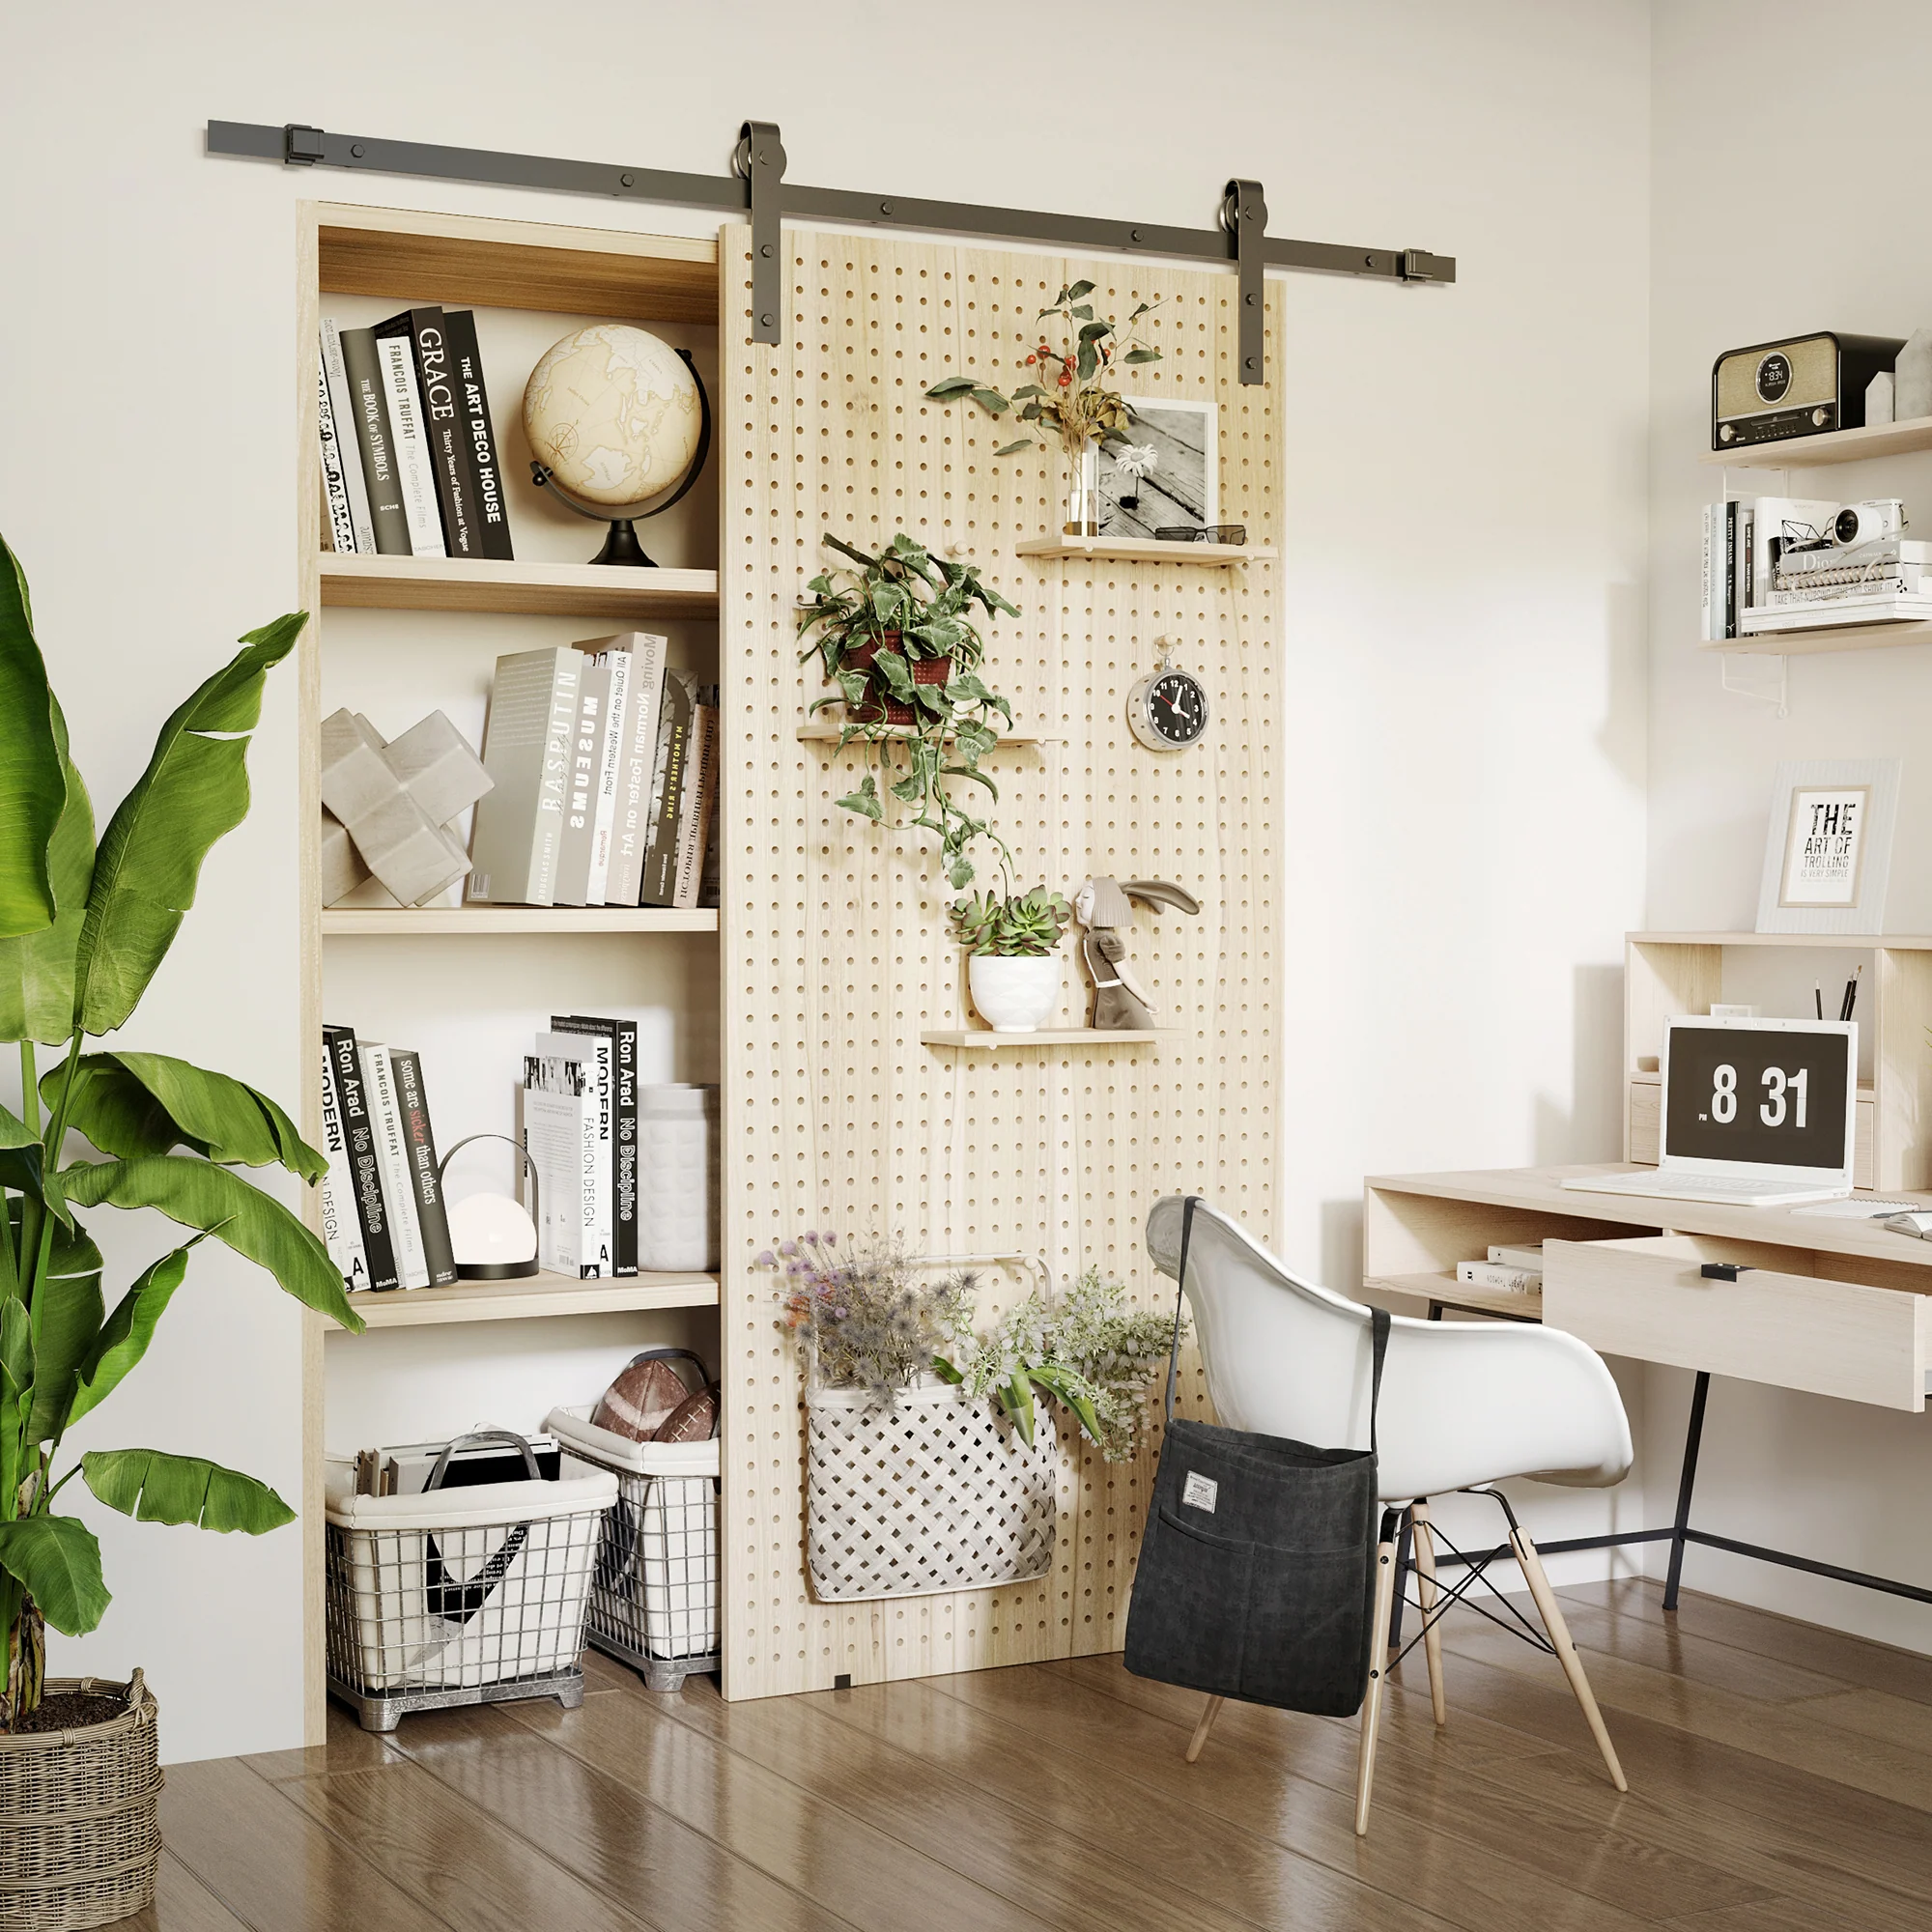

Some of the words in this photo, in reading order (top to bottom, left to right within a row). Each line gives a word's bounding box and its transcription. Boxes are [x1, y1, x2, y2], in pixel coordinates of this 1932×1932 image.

[389, 345, 407, 393] FRANCOIS
[419, 328, 454, 420] GRACE
[460, 356, 472, 379] THE
[361, 379, 370, 394] THE
[465, 384, 482, 415] ART
[366, 392, 380, 424] BOOK
[398, 398, 414, 440] TRUFFAT
[370, 422, 379, 436] OF
[442, 429, 454, 455] Thirty
[472, 421, 491, 462] DECO
[370, 433, 389, 481] SYMBOLS
[406, 444, 417, 461] The
[409, 463, 423, 504] Complete
[451, 475, 458, 486] of
[479, 468, 501, 524] HOUSE
[452, 482, 463, 514] Fashion
[415, 502, 426, 528] Films
[457, 515, 464, 526] at
[458, 526, 469, 552] Vogue
[1775, 593, 1788, 606] TAKE
[542, 671, 577, 812] RASPUTIN
[1811, 804, 1856, 835] THE
[1804, 838, 1831, 854] ART
[1835, 837, 1852, 854] OF
[1804, 856, 1849, 867] TROLLING
[538, 861, 550, 899] DOUGLAS
[544, 832, 553, 860] SMITH
[337, 1039, 354, 1074] Ron
[619, 1032, 635, 1063] Ron
[401, 1060, 415, 1089] some
[620, 1068, 635, 1106] Arad
[344, 1078, 364, 1118] Arad
[406, 1088, 419, 1108] are
[596, 1047, 609, 1140] MODERN
[1712, 1065, 1737, 1123] 8
[1760, 1066, 1807, 1127] 31
[353, 1127, 367, 1152] No
[409, 1109, 425, 1144] sicker
[620, 1118, 636, 1141] No
[374, 1054, 390, 1106] FRANCOIS
[384, 1111, 400, 1156] TRUFFAT
[396, 1182, 409, 1226] Complete
[405, 1229, 413, 1253] Films
[415, 1145, 432, 1174] than
[583, 1118, 594, 1174] FASHION
[357, 1155, 383, 1234] Discipline
[420, 1171, 436, 1205] others
[617, 1146, 636, 1221] Discipline
[583, 1179, 595, 1227] DESIGN
[376, 1278, 397, 1289] MoMA
